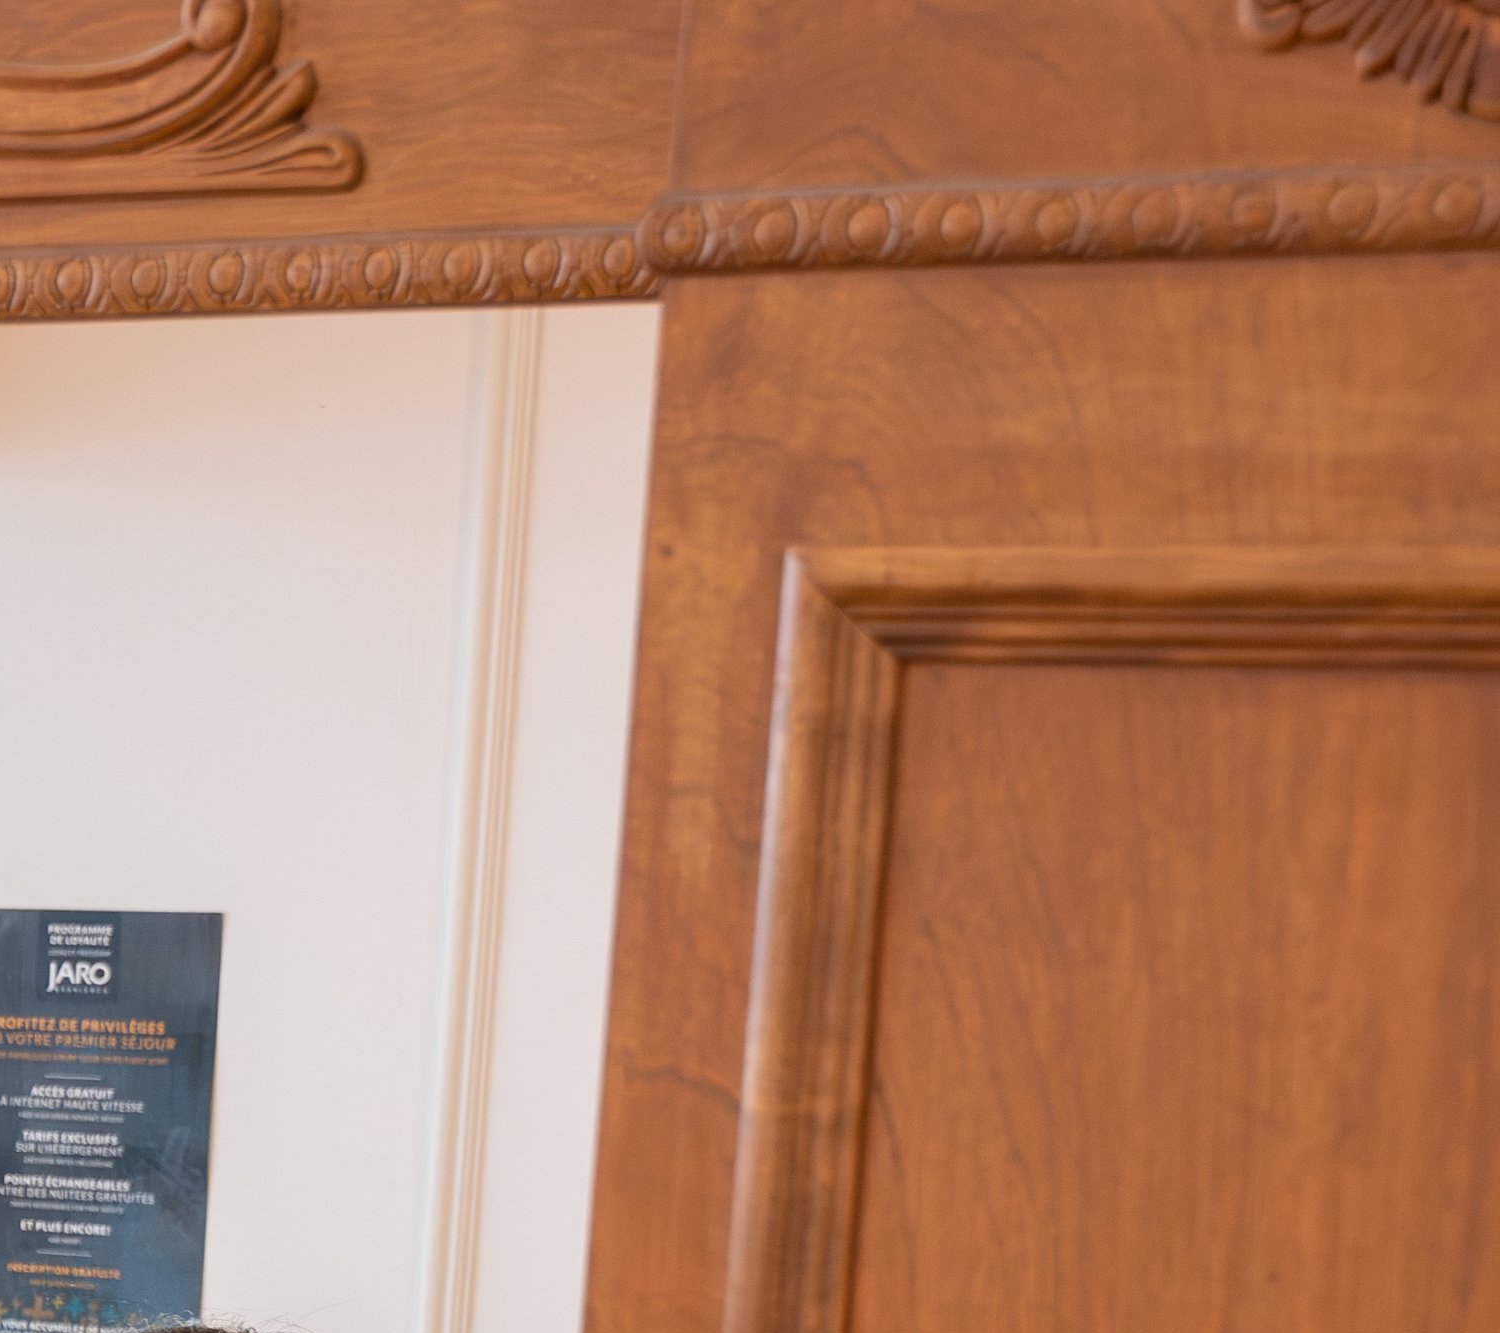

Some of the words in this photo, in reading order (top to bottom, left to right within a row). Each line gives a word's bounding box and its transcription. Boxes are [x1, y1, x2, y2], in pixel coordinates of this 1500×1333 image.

[46, 960, 112, 992] JARO
[58, 1017, 77, 1032] DE
[81, 1017, 166, 1035] PRIVILÈGES
[5, 1032, 51, 1047] VOTRE
[55, 1033, 117, 1048] PREMIER
[9, 1095, 62, 1109] INTERNET
[100, 1101, 144, 1114] VITESSE
[20, 1219, 34, 1231] ET
[35, 1220, 62, 1233] PLUS
